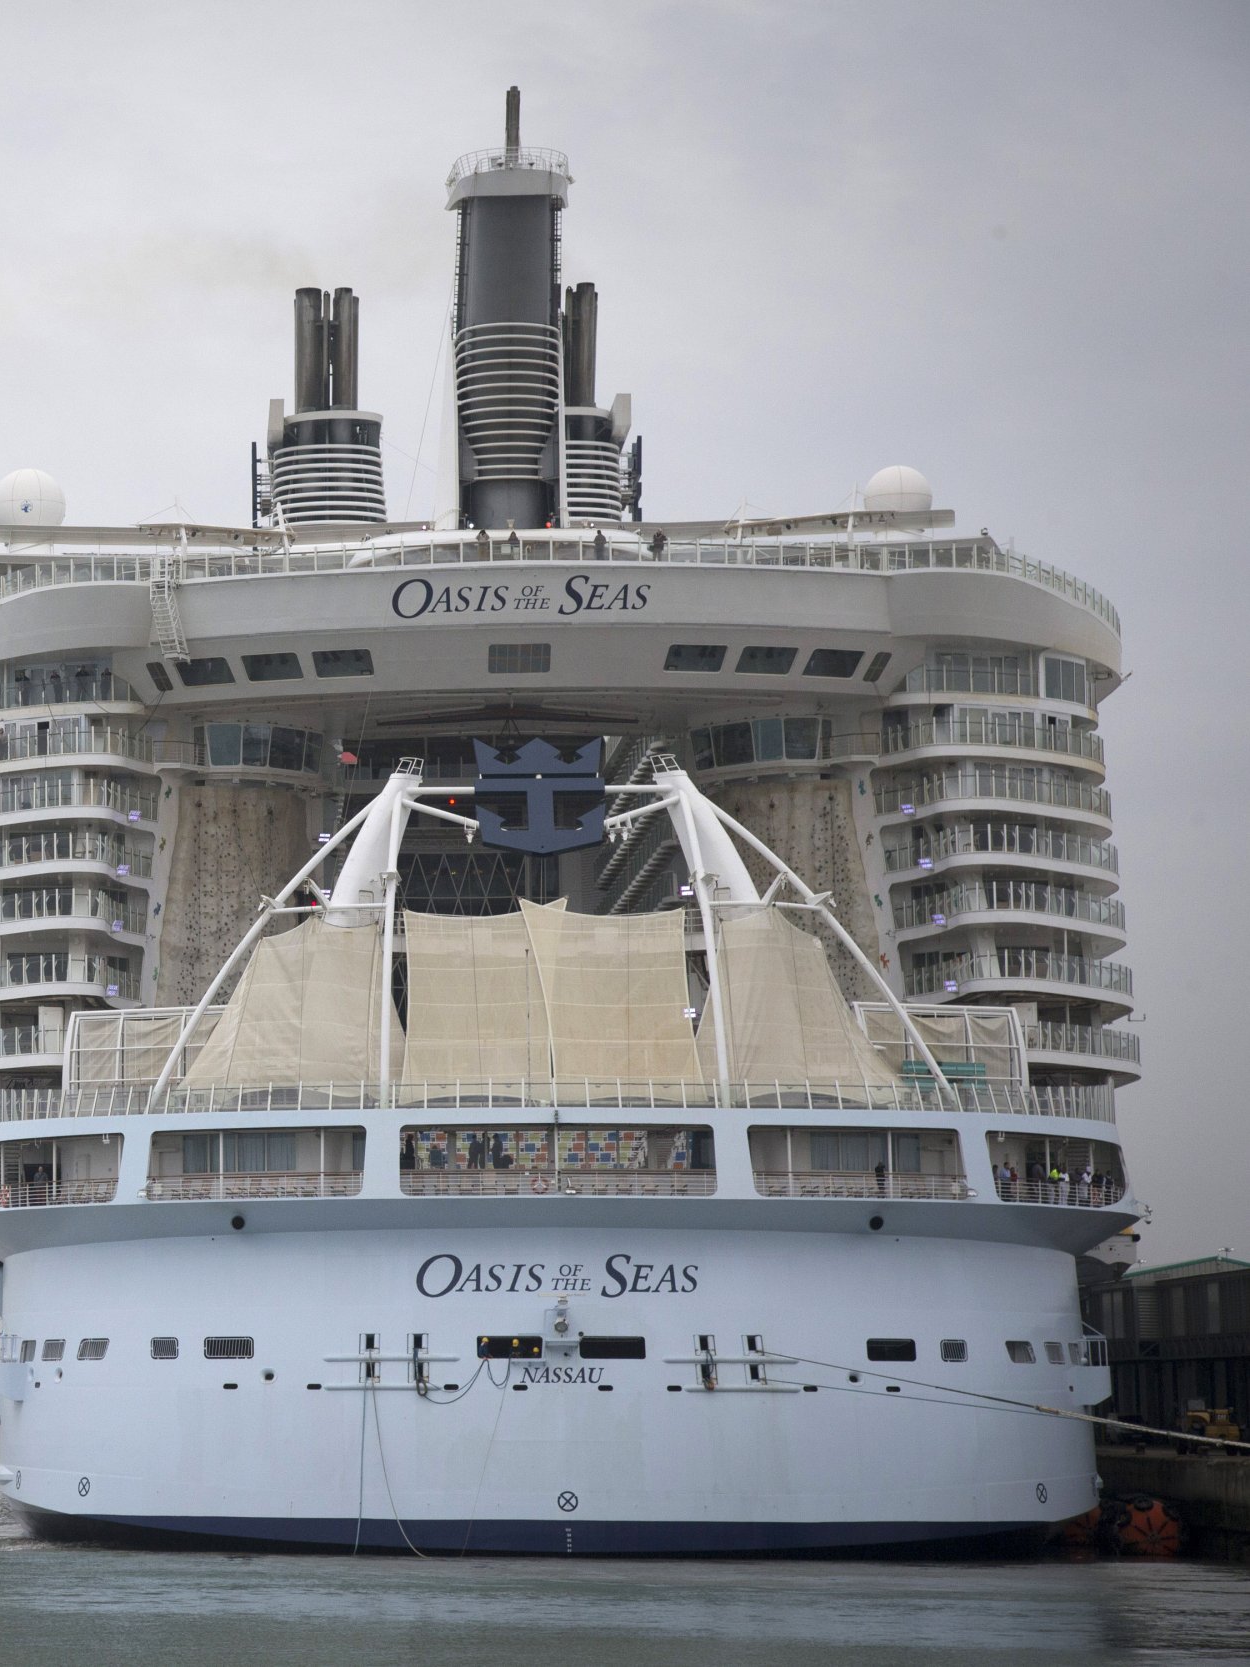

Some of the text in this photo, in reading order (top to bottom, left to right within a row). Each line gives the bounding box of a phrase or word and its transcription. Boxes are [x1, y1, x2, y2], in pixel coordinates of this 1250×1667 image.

[392, 575, 651, 619] OASIS OF THE SEAS
[415, 1254, 699, 1298] OASIS OF THE SEAS
[520, 1367, 604, 1384] NASSAU
